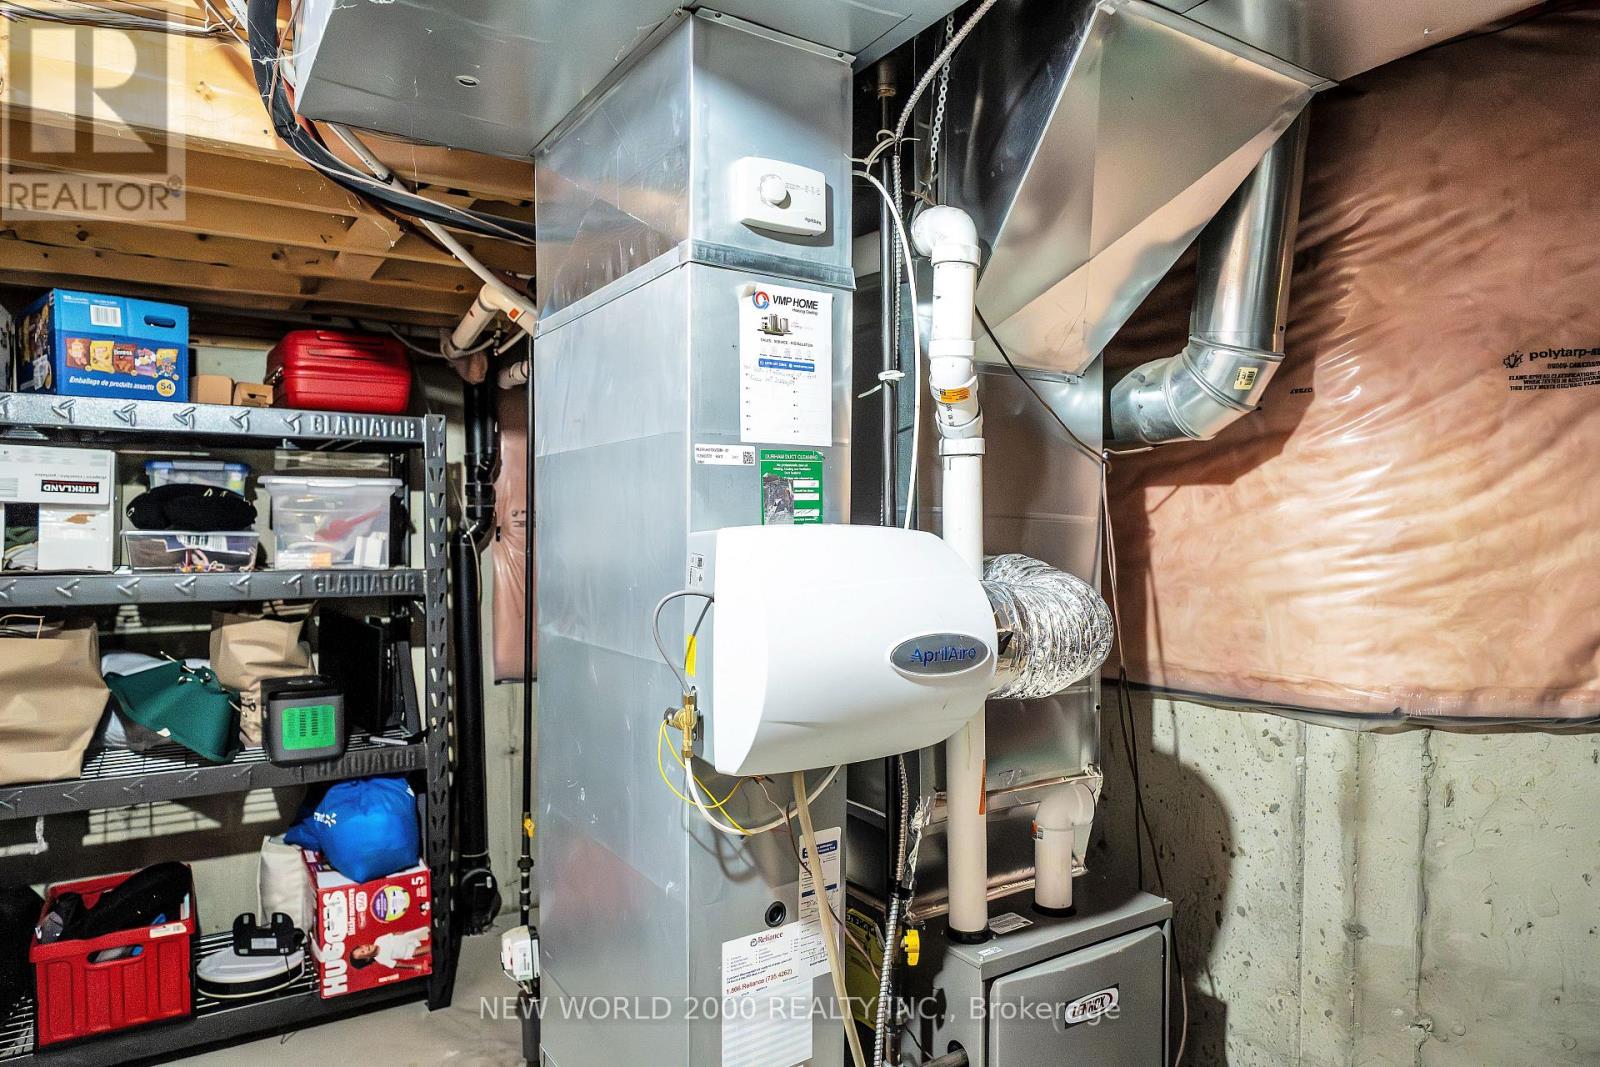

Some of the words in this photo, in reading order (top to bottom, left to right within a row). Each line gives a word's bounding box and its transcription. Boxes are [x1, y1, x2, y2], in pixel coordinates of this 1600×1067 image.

[773, 294, 792, 306] VMP
[793, 298, 819, 310] HOME
[309, 414, 416, 439] GLADIATOR
[43, 484, 97, 493] KIRKLAND
[312, 573, 416, 596] GLADIATOR
[911, 646, 977, 667] AprilAire
[757, 931, 784, 944] Reliance
[1071, 995, 1106, 1017] LENNOX
